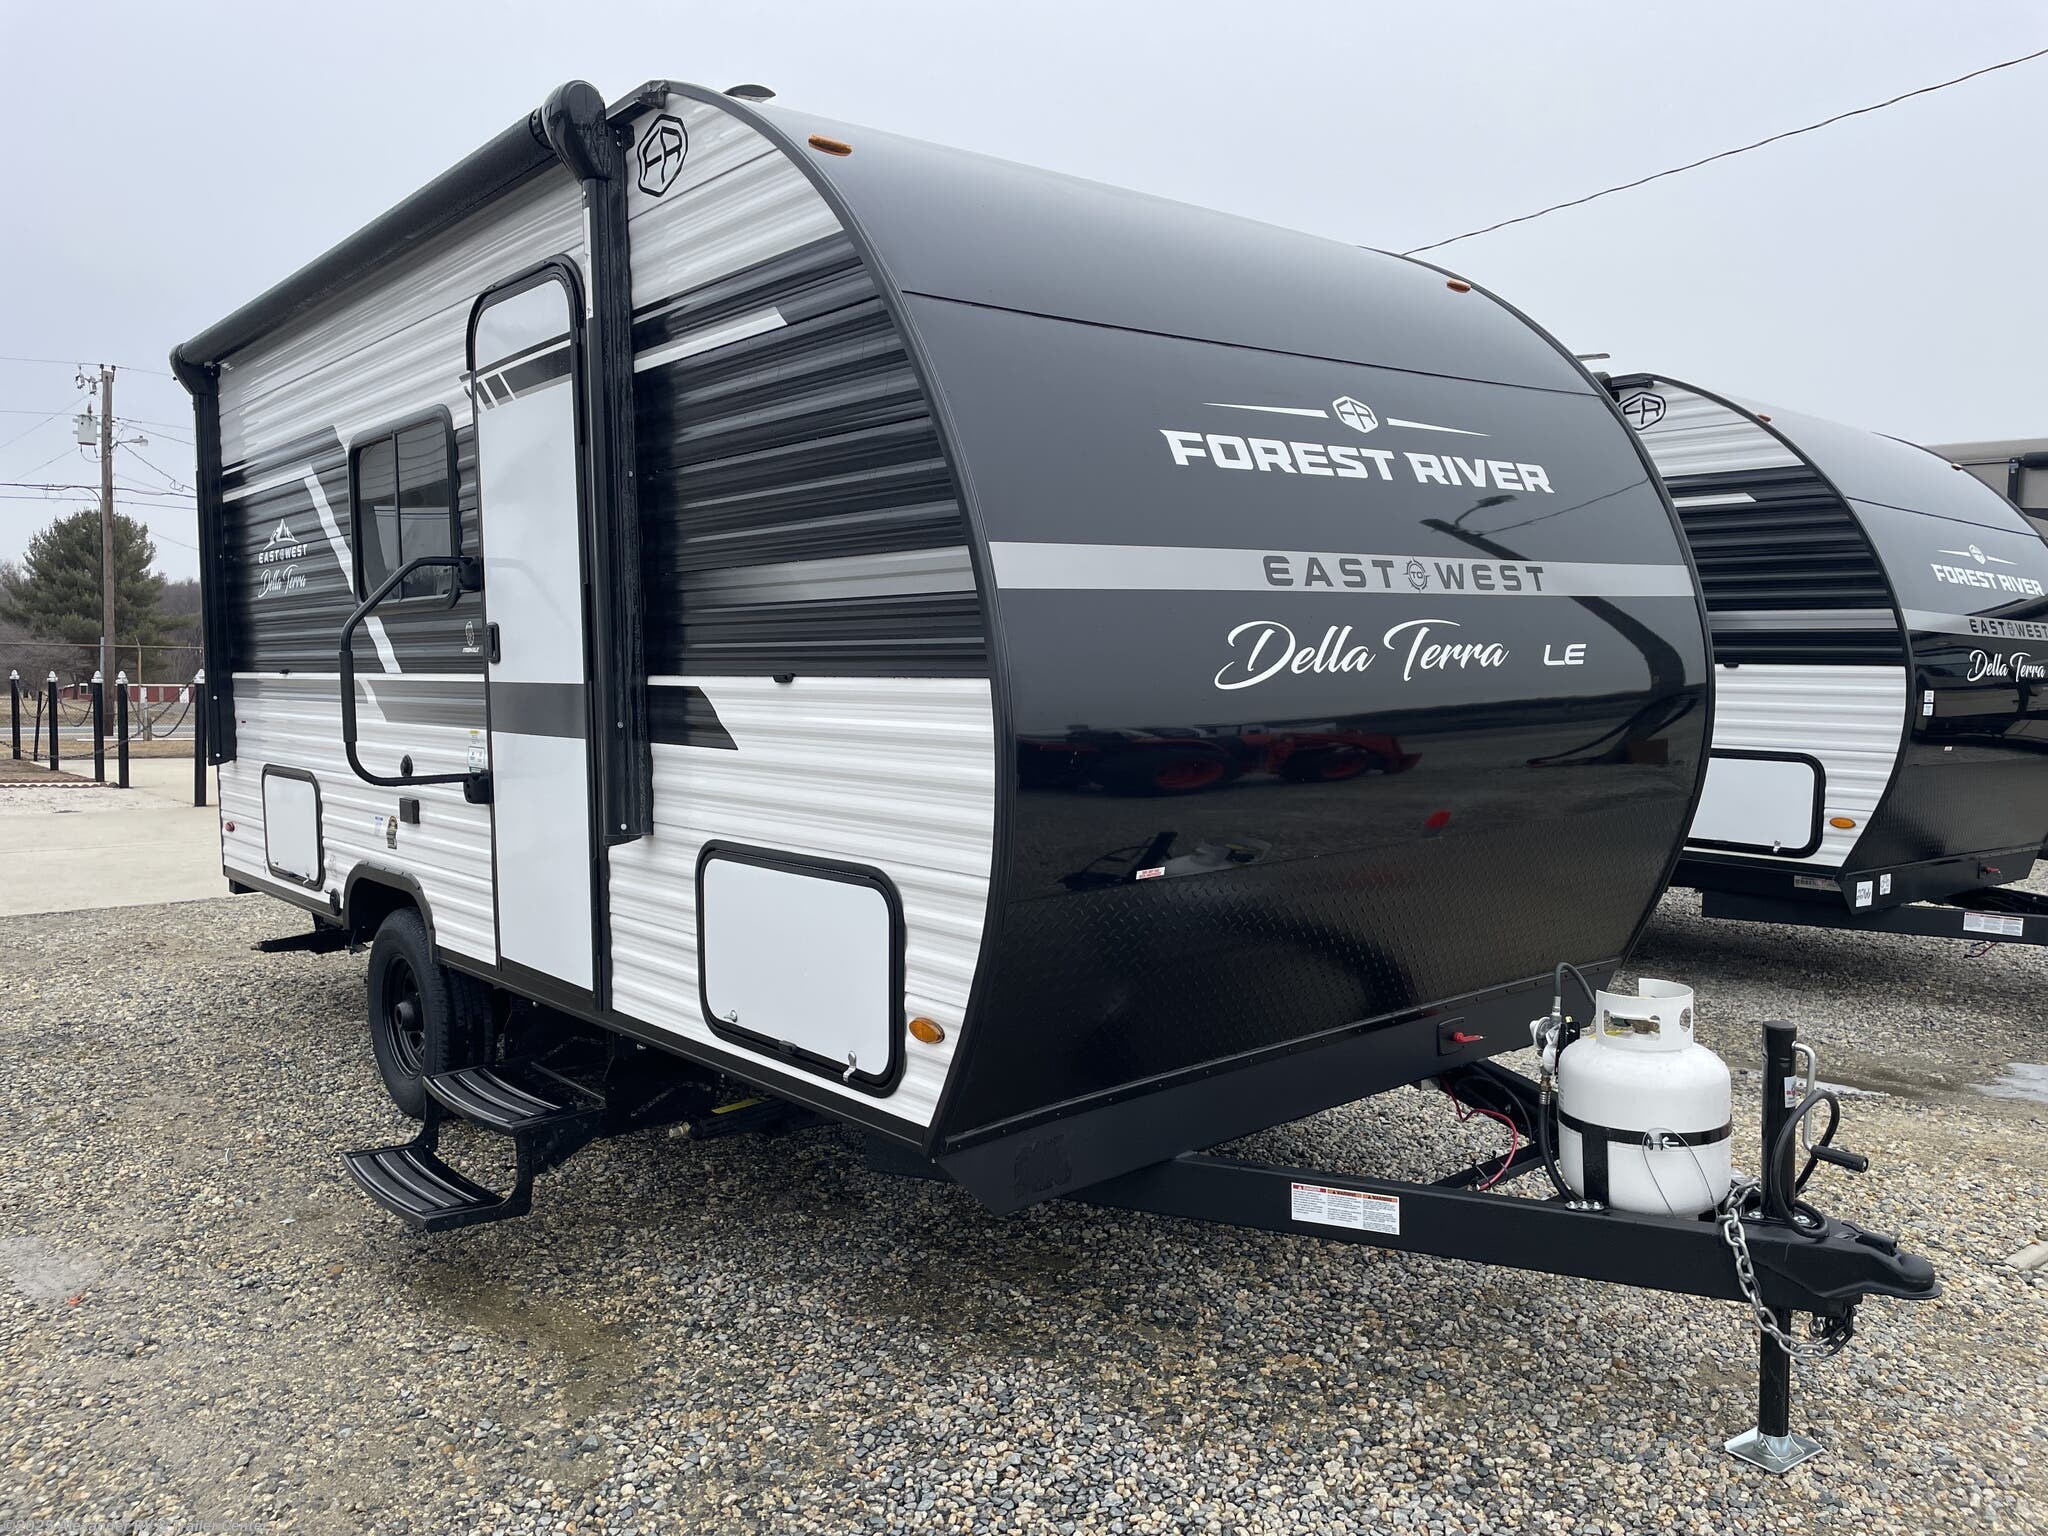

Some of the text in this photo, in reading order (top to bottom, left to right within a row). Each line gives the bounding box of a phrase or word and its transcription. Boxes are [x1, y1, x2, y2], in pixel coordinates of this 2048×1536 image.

[1159, 429, 1556, 494] FOREST RIVER
[258, 544, 308, 564] EAST WEST
[1262, 555, 1395, 589] EAST
[1434, 562, 1545, 592] WEST
[1930, 563, 2046, 597] FOREST RIVER
[1969, 618, 2007, 636] EAST
[1214, 619, 1587, 690] Della Terra LE
[1967, 649, 2047, 683] Della Terra
